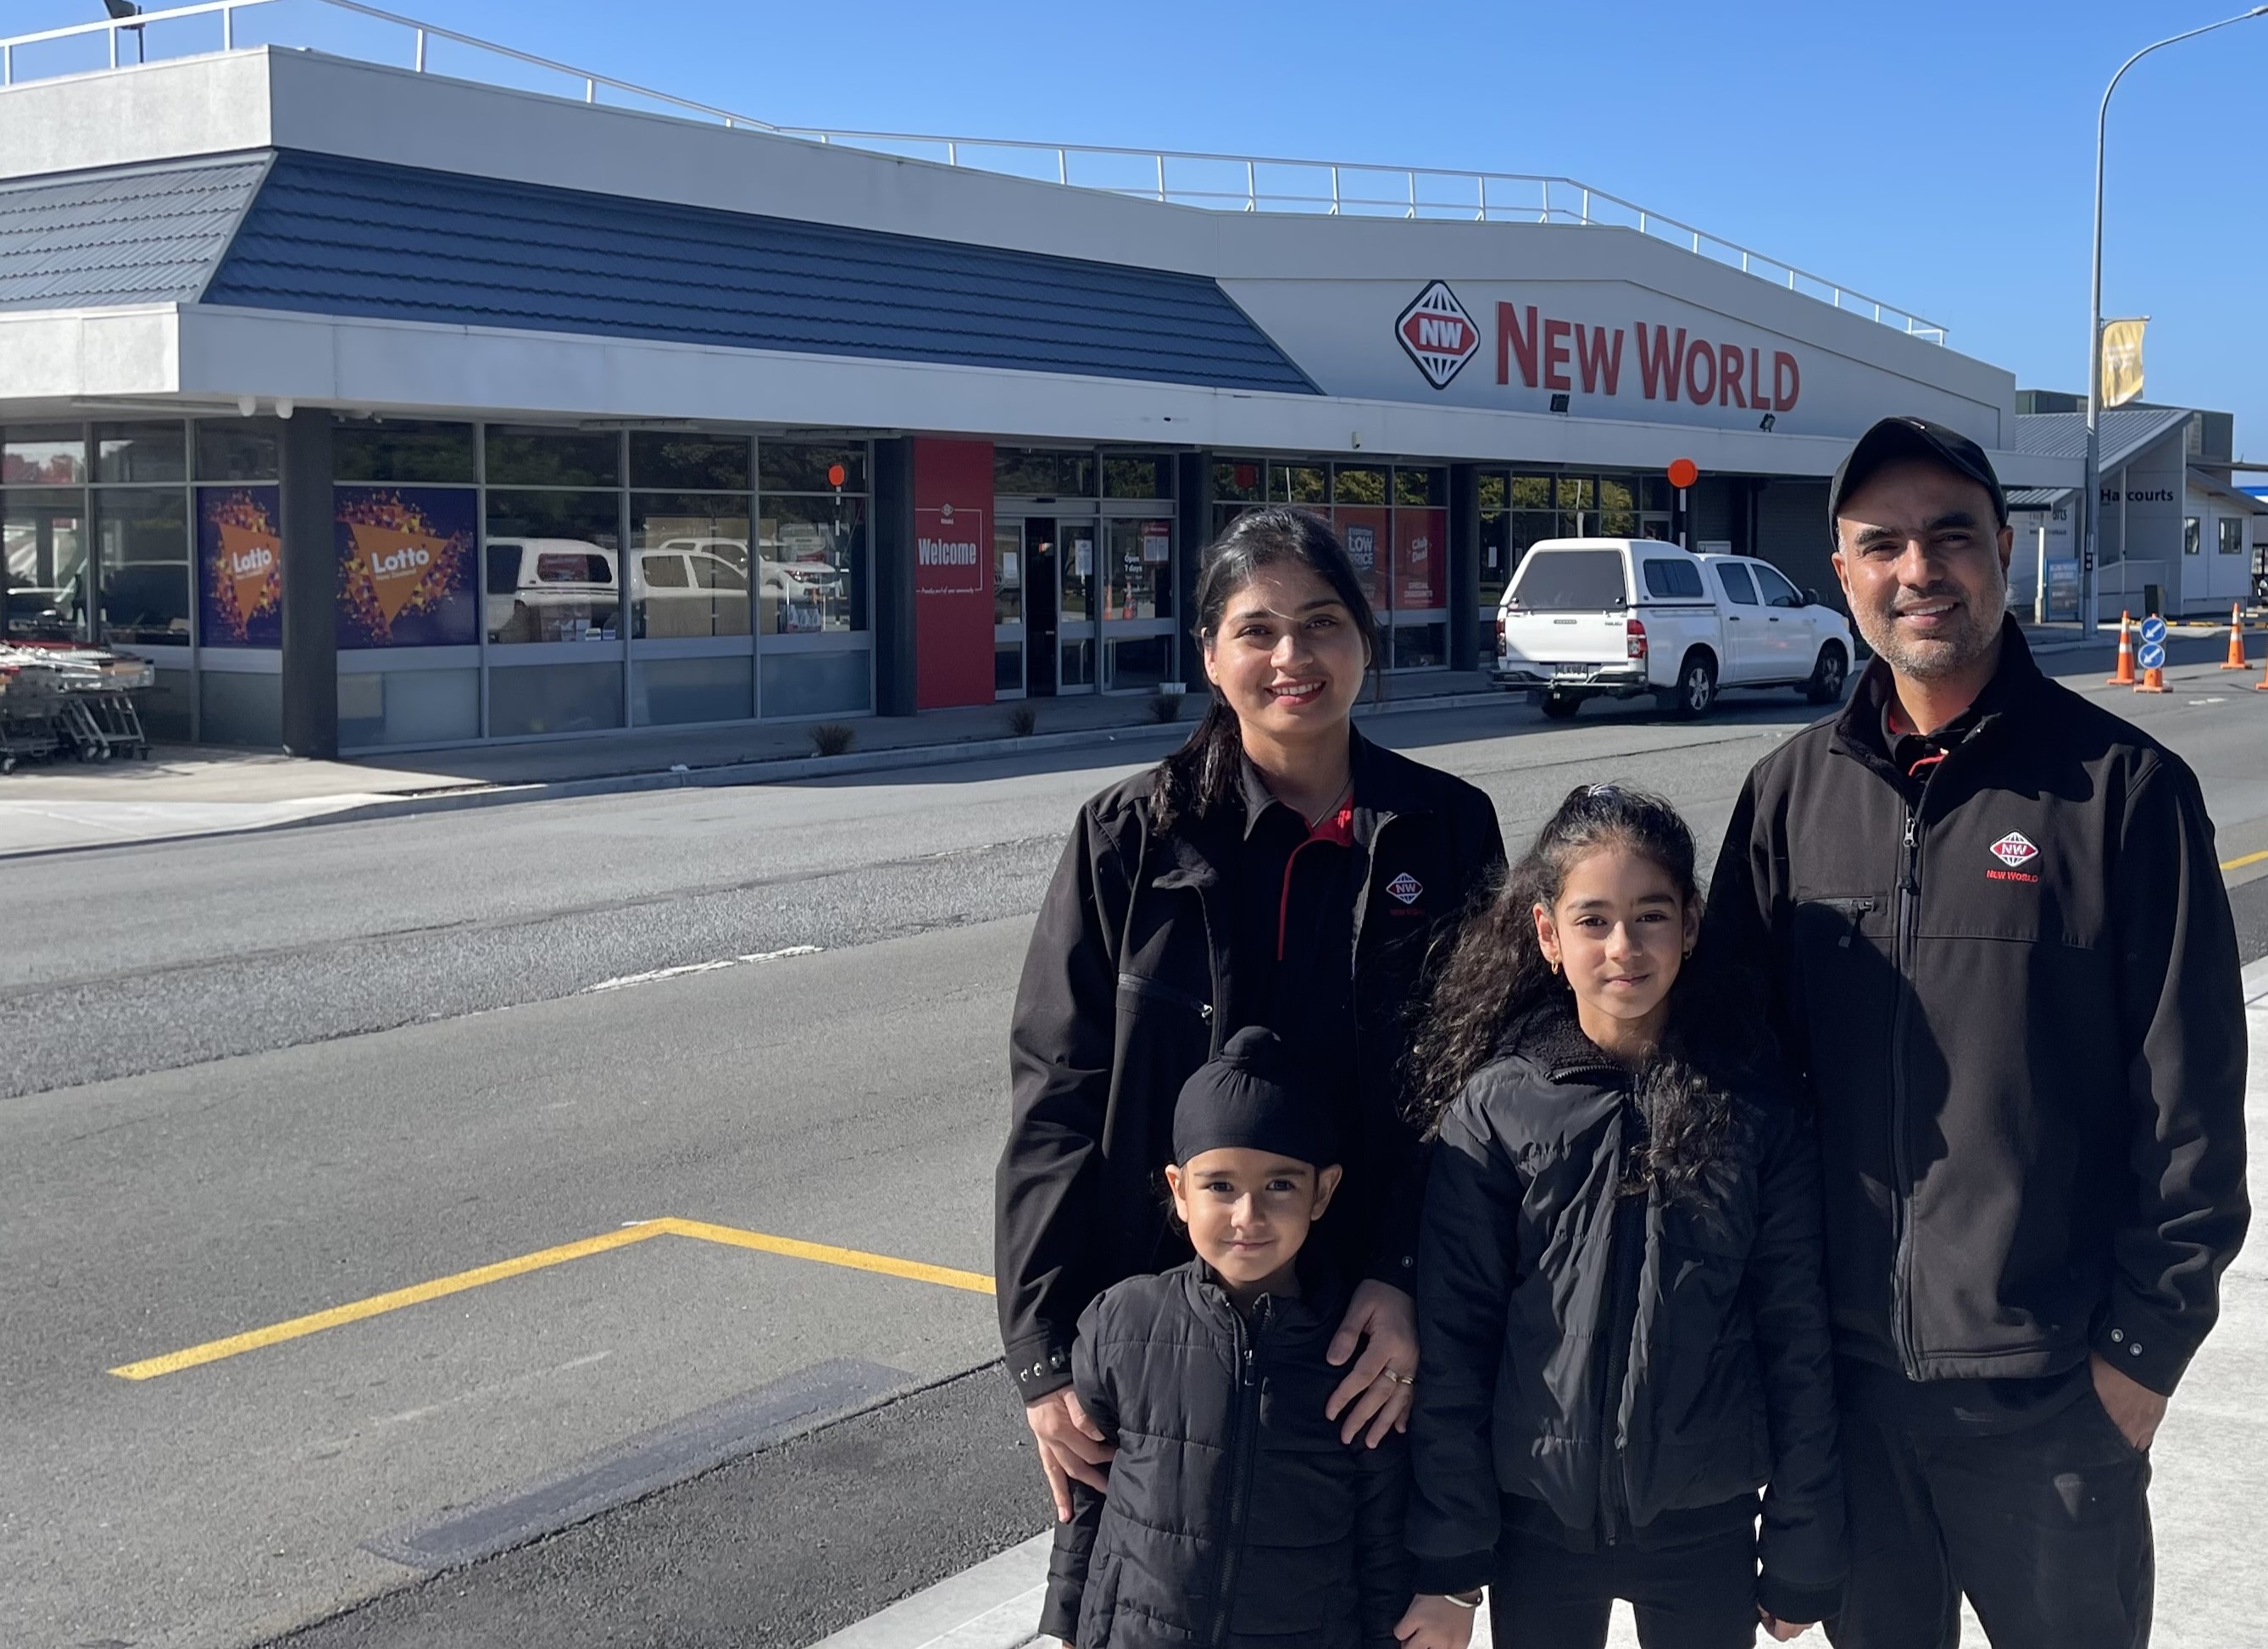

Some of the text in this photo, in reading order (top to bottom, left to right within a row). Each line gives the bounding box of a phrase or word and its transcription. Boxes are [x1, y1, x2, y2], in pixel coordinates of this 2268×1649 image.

[1419, 317, 1464, 349] NW
[1496, 300, 1800, 412] NEW WORLD
[2101, 488, 2173, 502] Hacourts
[918, 538, 976, 565] Welcome
[1348, 536, 1374, 552] LOW
[232, 547, 272, 574] Lotto
[371, 547, 430, 574] Lotto
[2001, 843, 2028, 856] NW
[1986, 869, 2039, 883] NEW WORLD
[1396, 883, 1416, 894] NW
